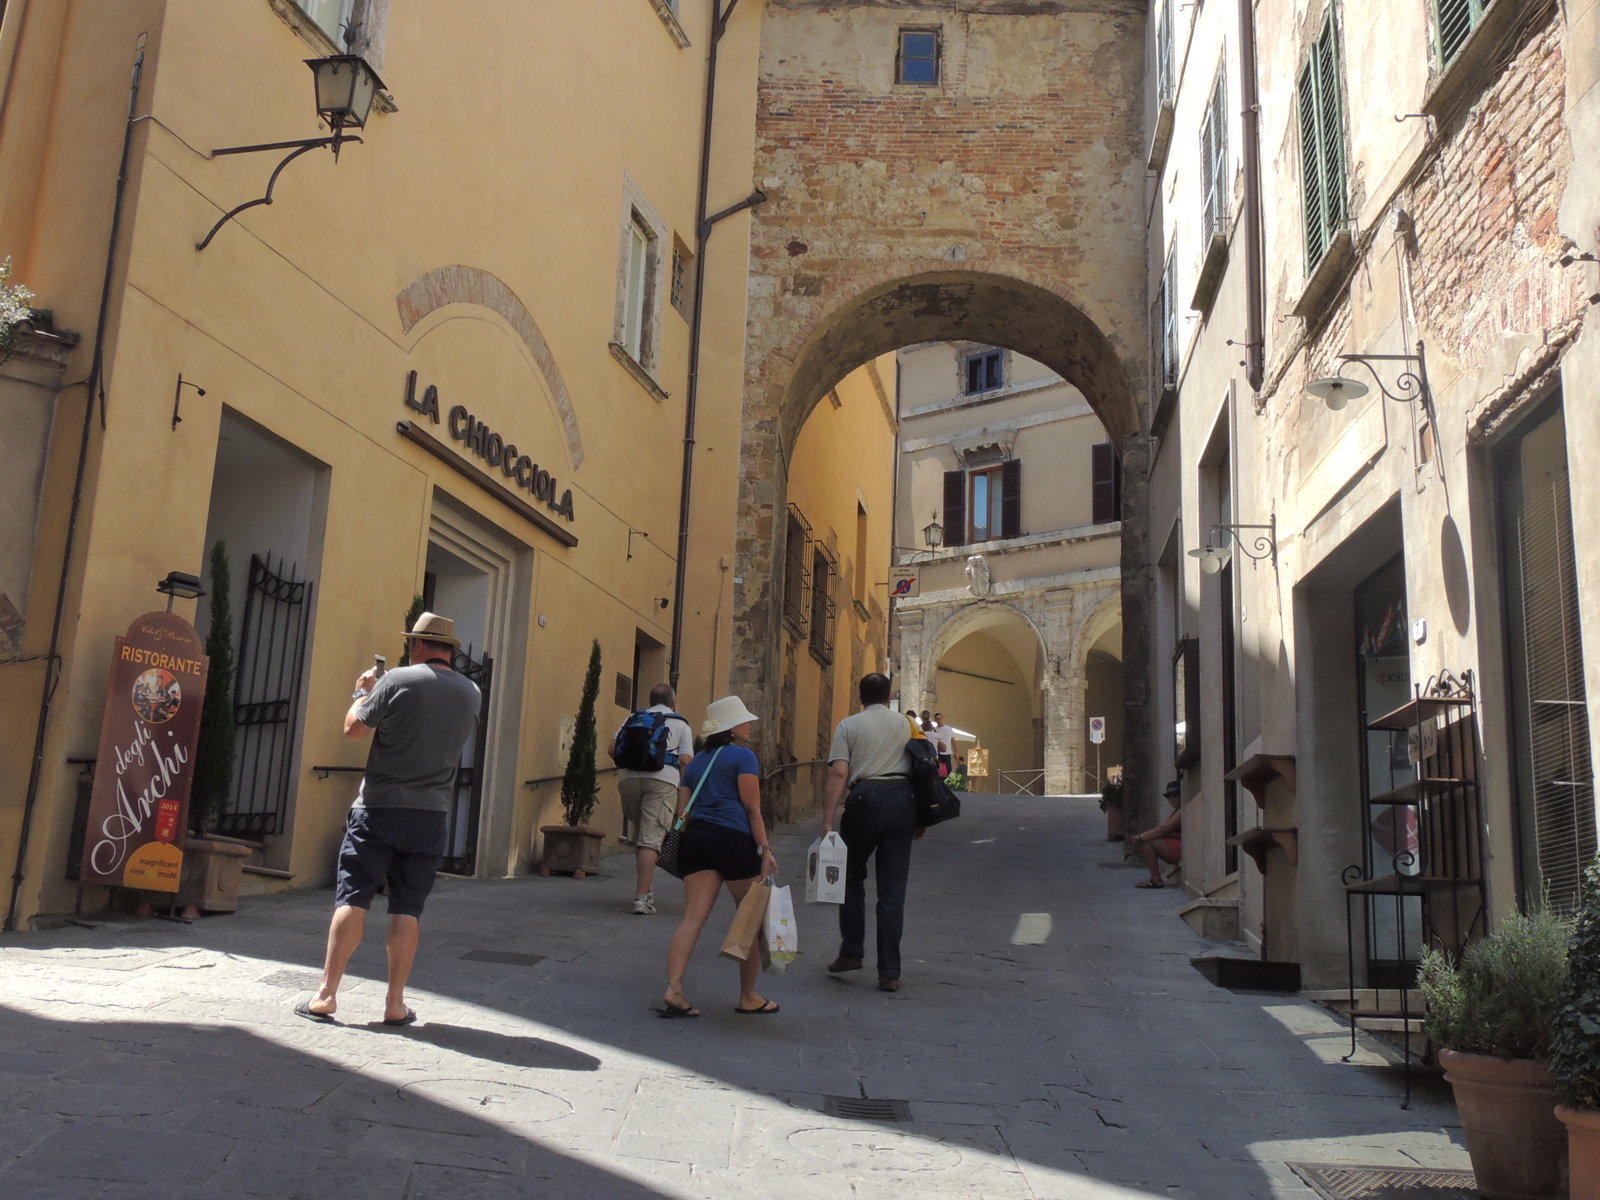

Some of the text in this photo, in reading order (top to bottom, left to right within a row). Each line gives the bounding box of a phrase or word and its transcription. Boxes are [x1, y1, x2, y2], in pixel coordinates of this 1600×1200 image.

[404, 370, 575, 522] LA CHIOCCIOLA
[121, 645, 202, 675] RISTORANTE
[115, 720, 151, 775] degli
[91, 730, 188, 875] Archi
[160, 803, 178, 811] 2014
[129, 867, 177, 879] view inside
[139, 859, 179, 869] magnificent
